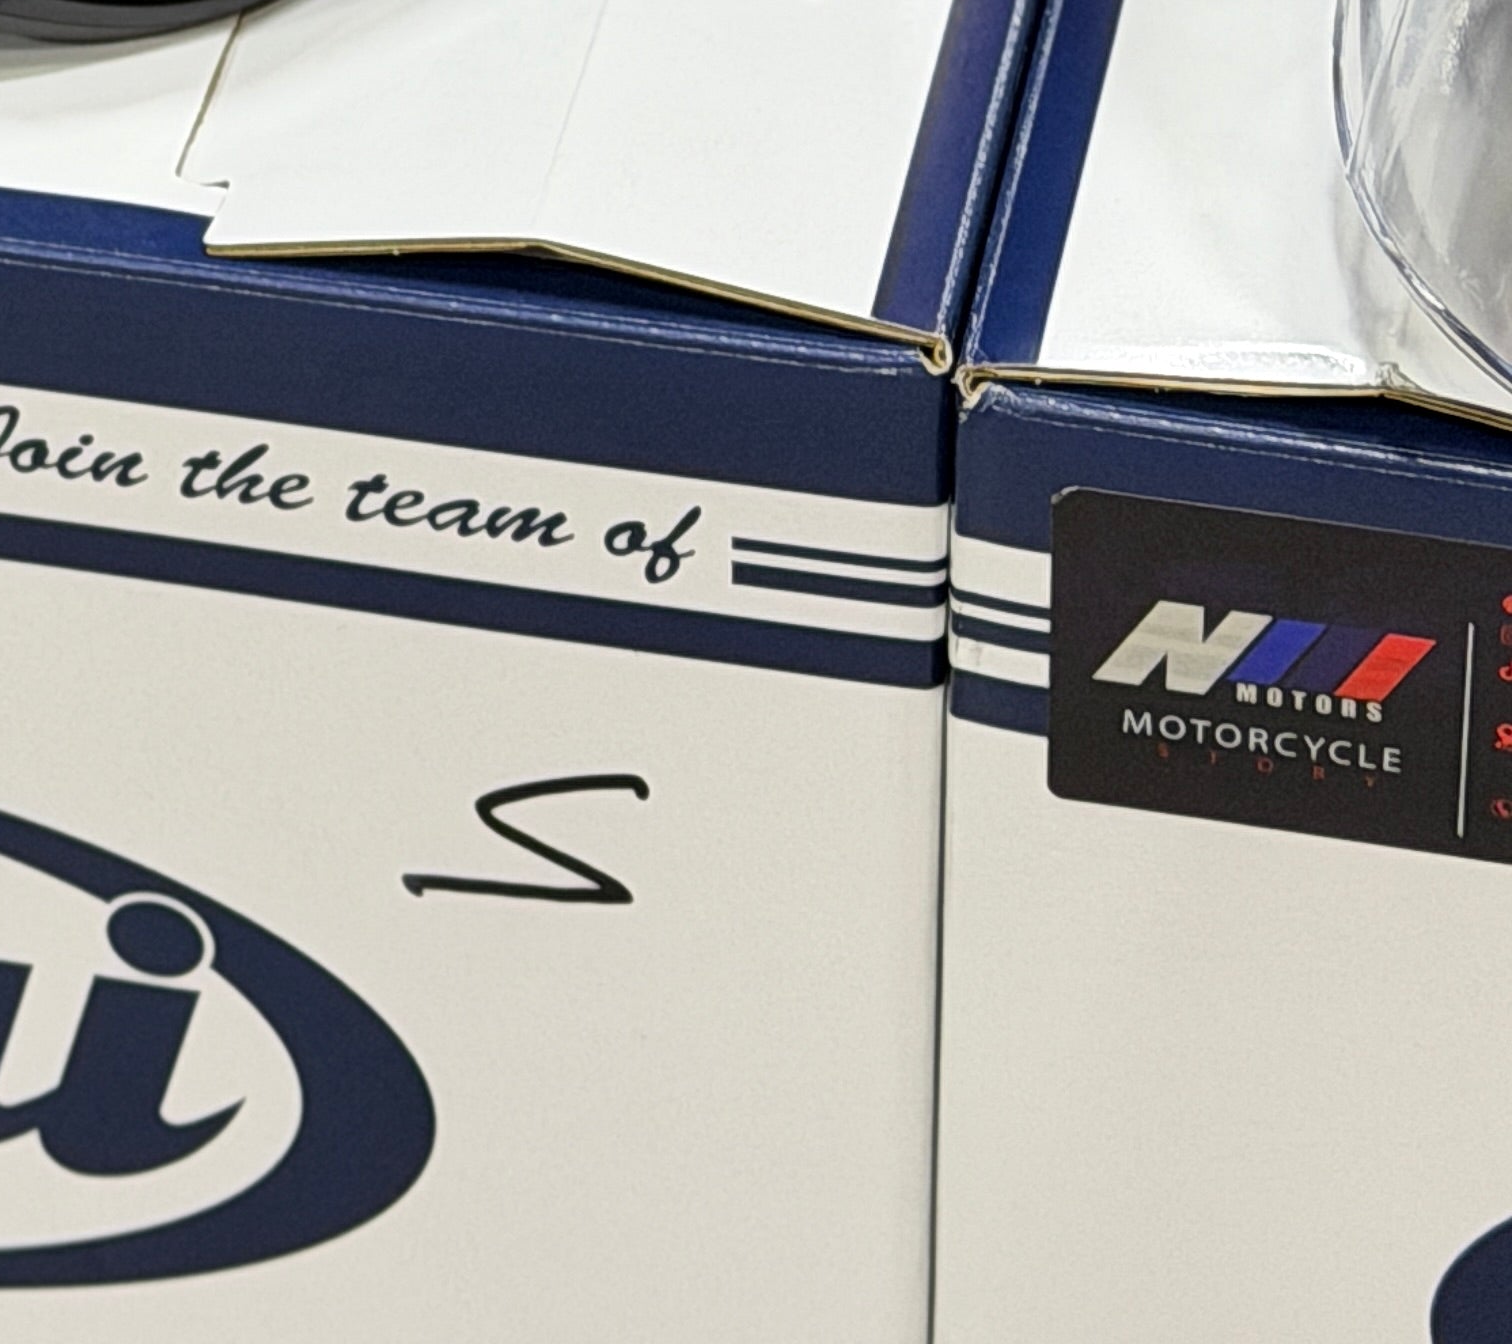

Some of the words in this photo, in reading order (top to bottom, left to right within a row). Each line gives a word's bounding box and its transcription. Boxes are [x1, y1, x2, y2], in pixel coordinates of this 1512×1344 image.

[178, 442, 315, 511] the
[345, 470, 575, 551] team
[603, 505, 702, 585] of
[1235, 681, 1383, 724] MOTORS
[1122, 708, 1402, 773] MOTORCYCLE
